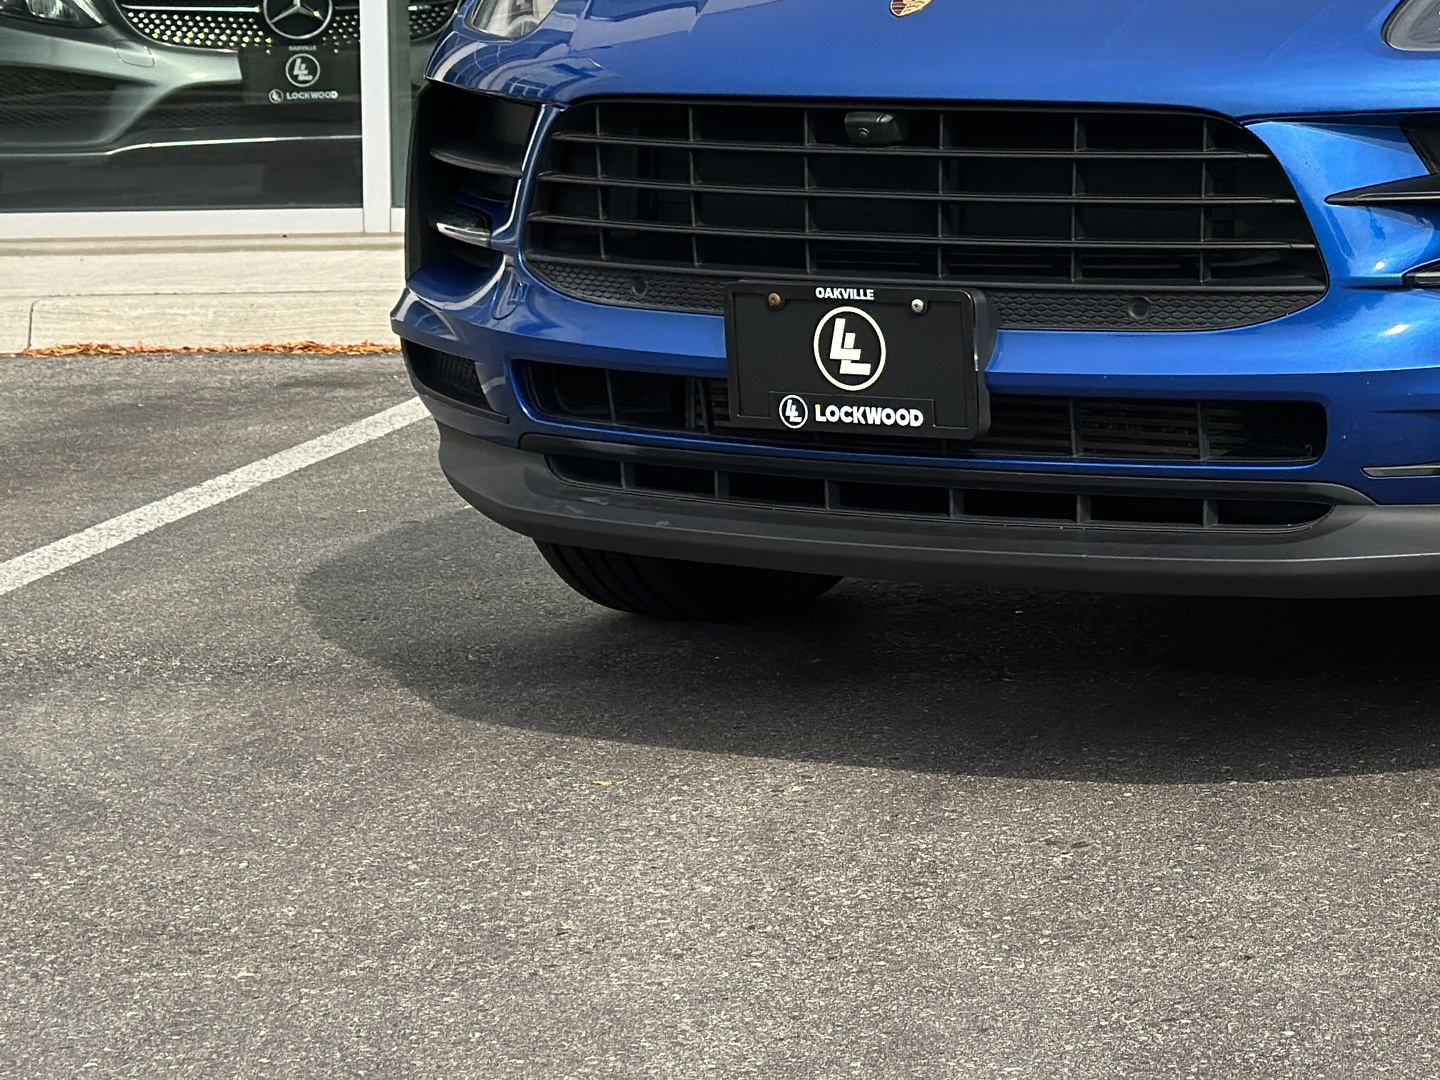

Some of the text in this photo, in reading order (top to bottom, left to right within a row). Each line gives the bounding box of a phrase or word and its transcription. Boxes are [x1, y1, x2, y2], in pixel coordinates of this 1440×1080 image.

[286, 90, 339, 100] LOCKWOOD
[815, 287, 875, 301] OAKVILLE
[814, 403, 924, 427] LOCKWOOD
